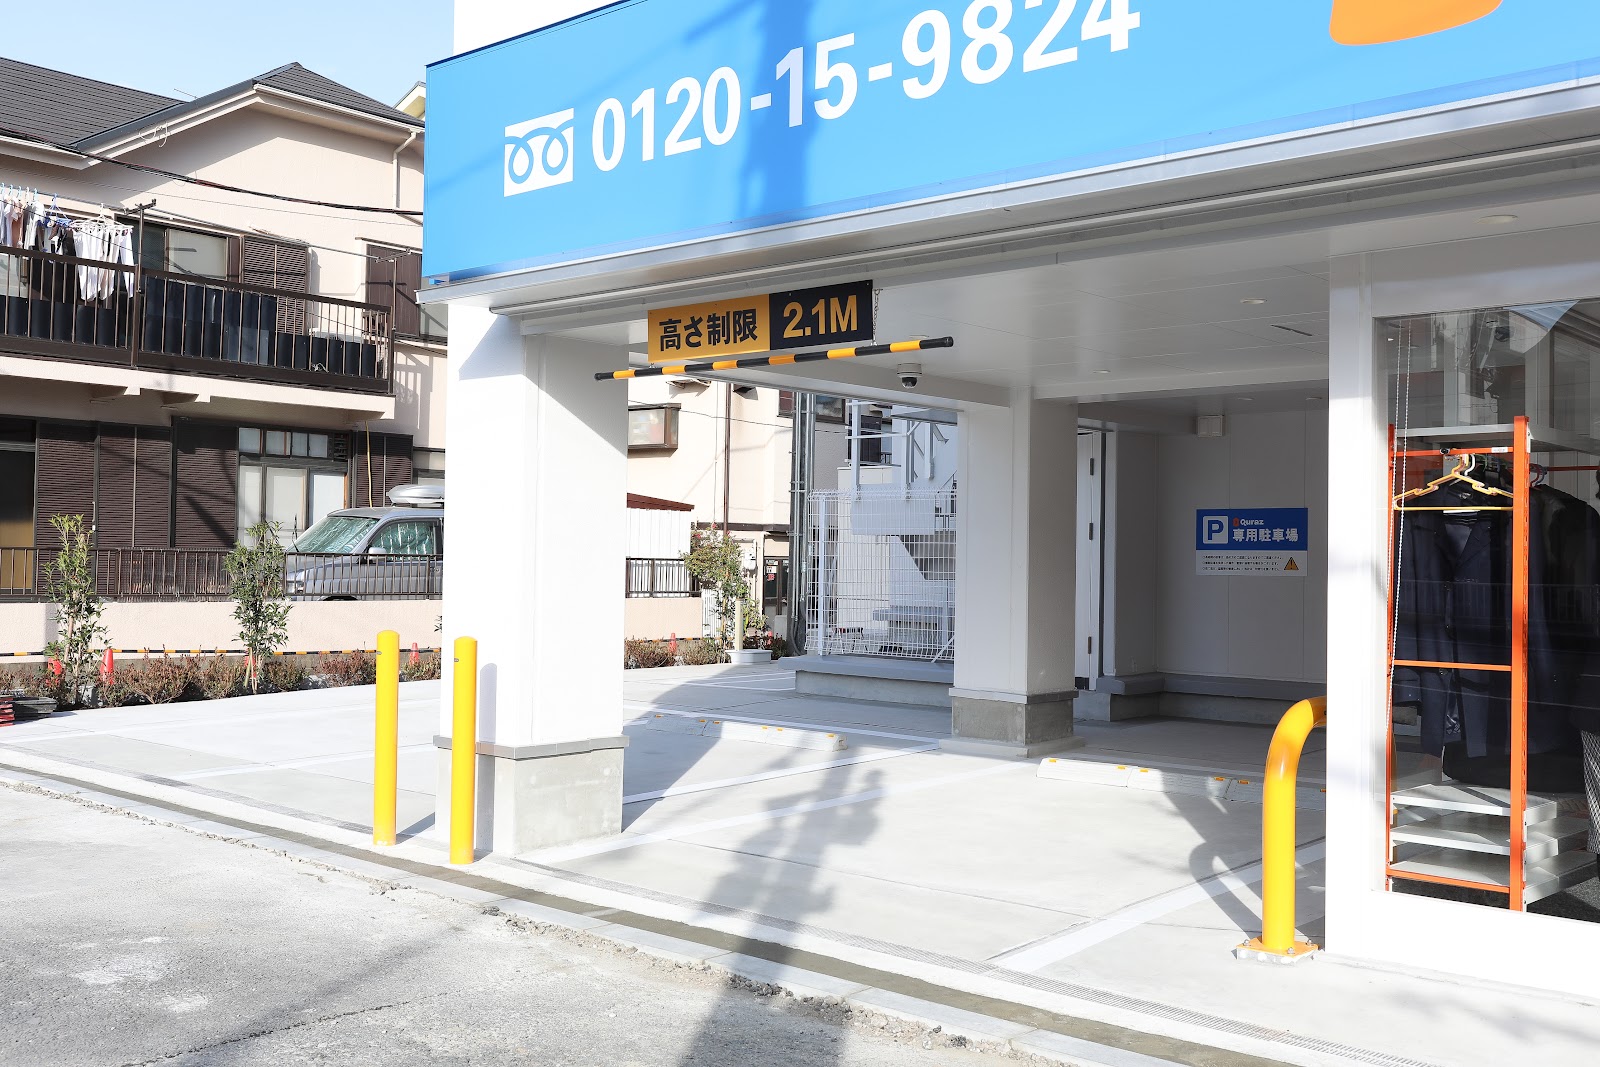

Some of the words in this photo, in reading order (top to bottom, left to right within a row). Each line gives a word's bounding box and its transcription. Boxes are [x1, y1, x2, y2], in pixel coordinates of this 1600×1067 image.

[591, 0, 1141, 172] 0120-15-9824
[658, 308, 758, 351] 高さ制限
[782, 295, 858, 339] 2.1M
[1207, 519, 1225, 541] P
[1240, 518, 1264, 526] Quraz
[1232, 528, 1299, 542] 専用駐車場
